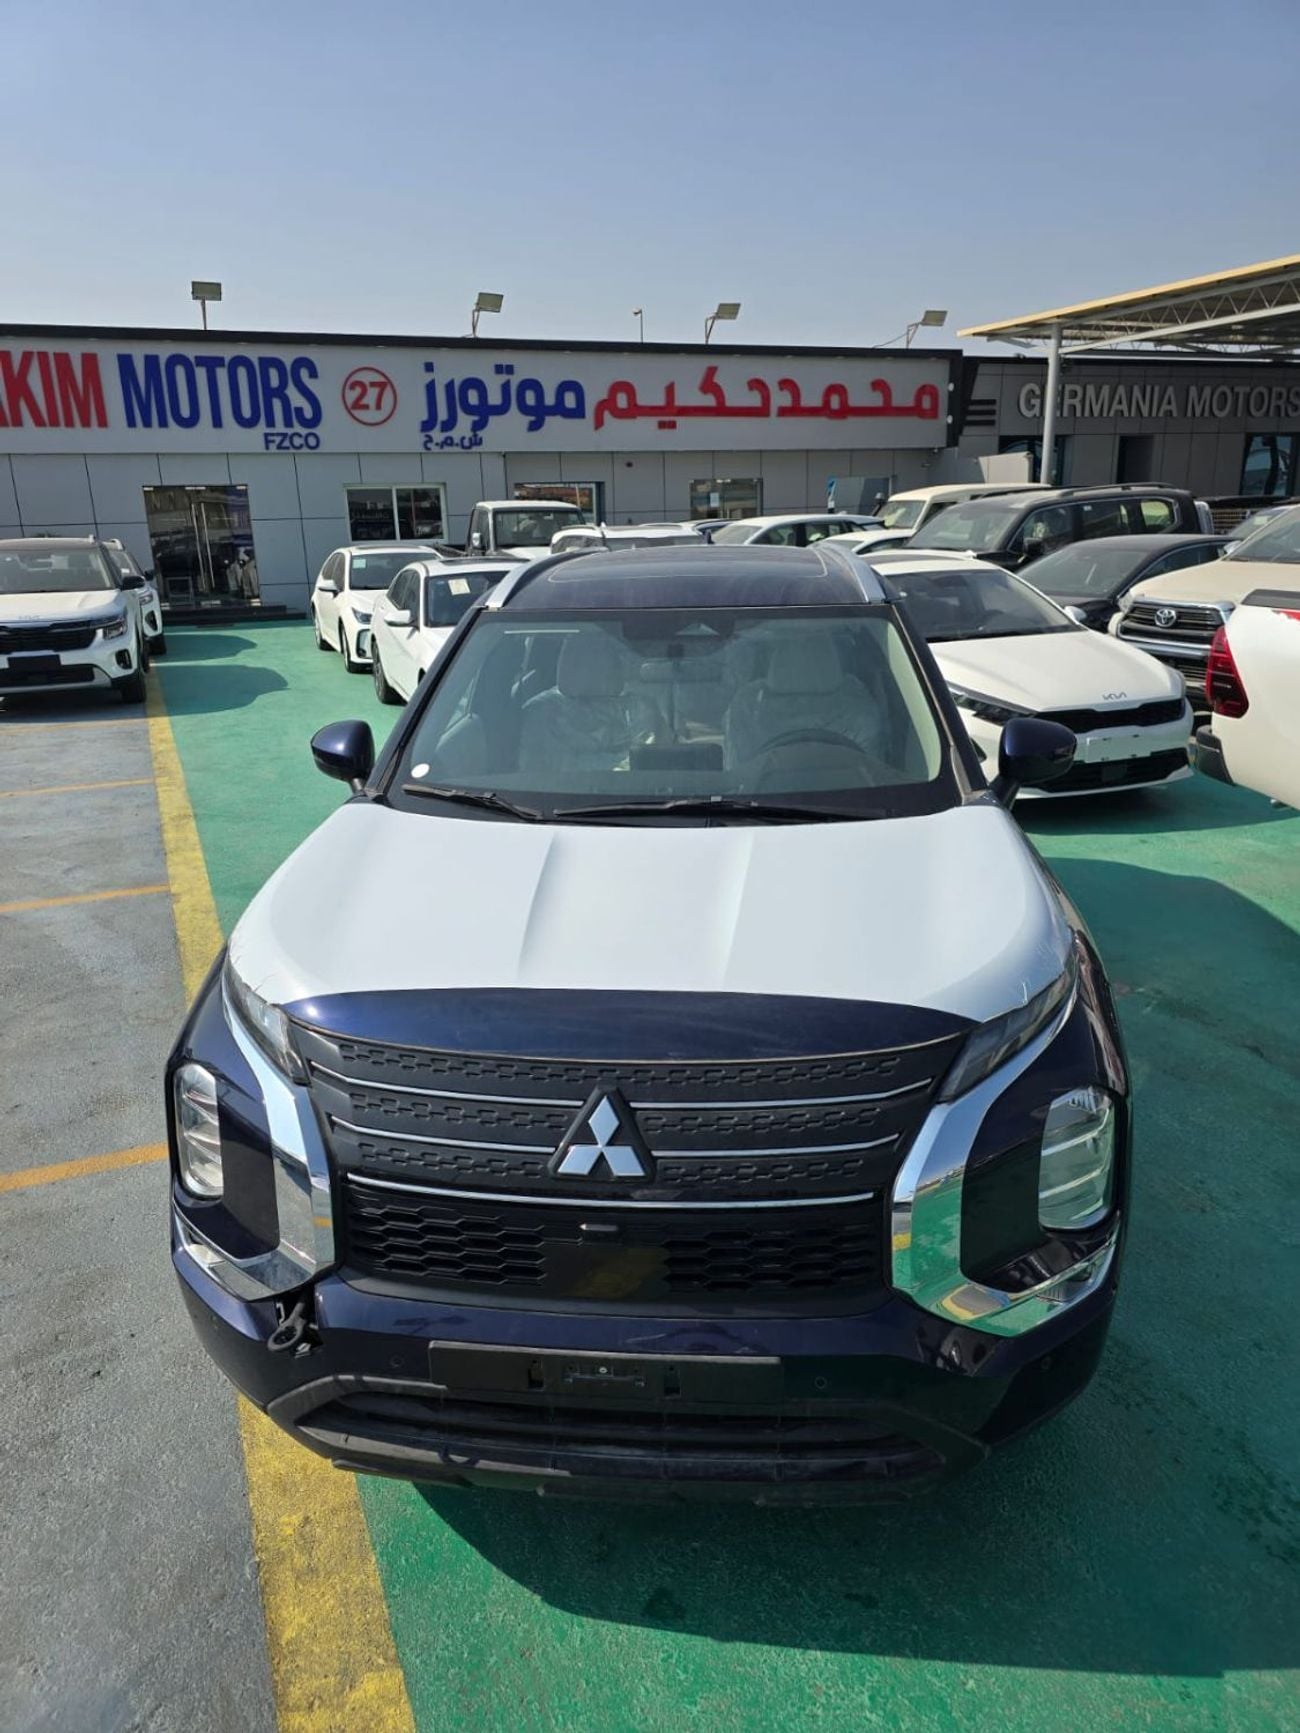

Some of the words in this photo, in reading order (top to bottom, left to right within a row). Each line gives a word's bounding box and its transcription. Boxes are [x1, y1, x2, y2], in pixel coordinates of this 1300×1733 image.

[116, 353, 323, 429] MOTORS
[349, 381, 388, 411] 27
[420, 361, 586, 432] موتورز
[593, 366, 771, 430] حكيم
[777, 377, 939, 421] محمد
[1186, 385, 1300, 418] MOTORS
[263, 432, 320, 450] FZCO
